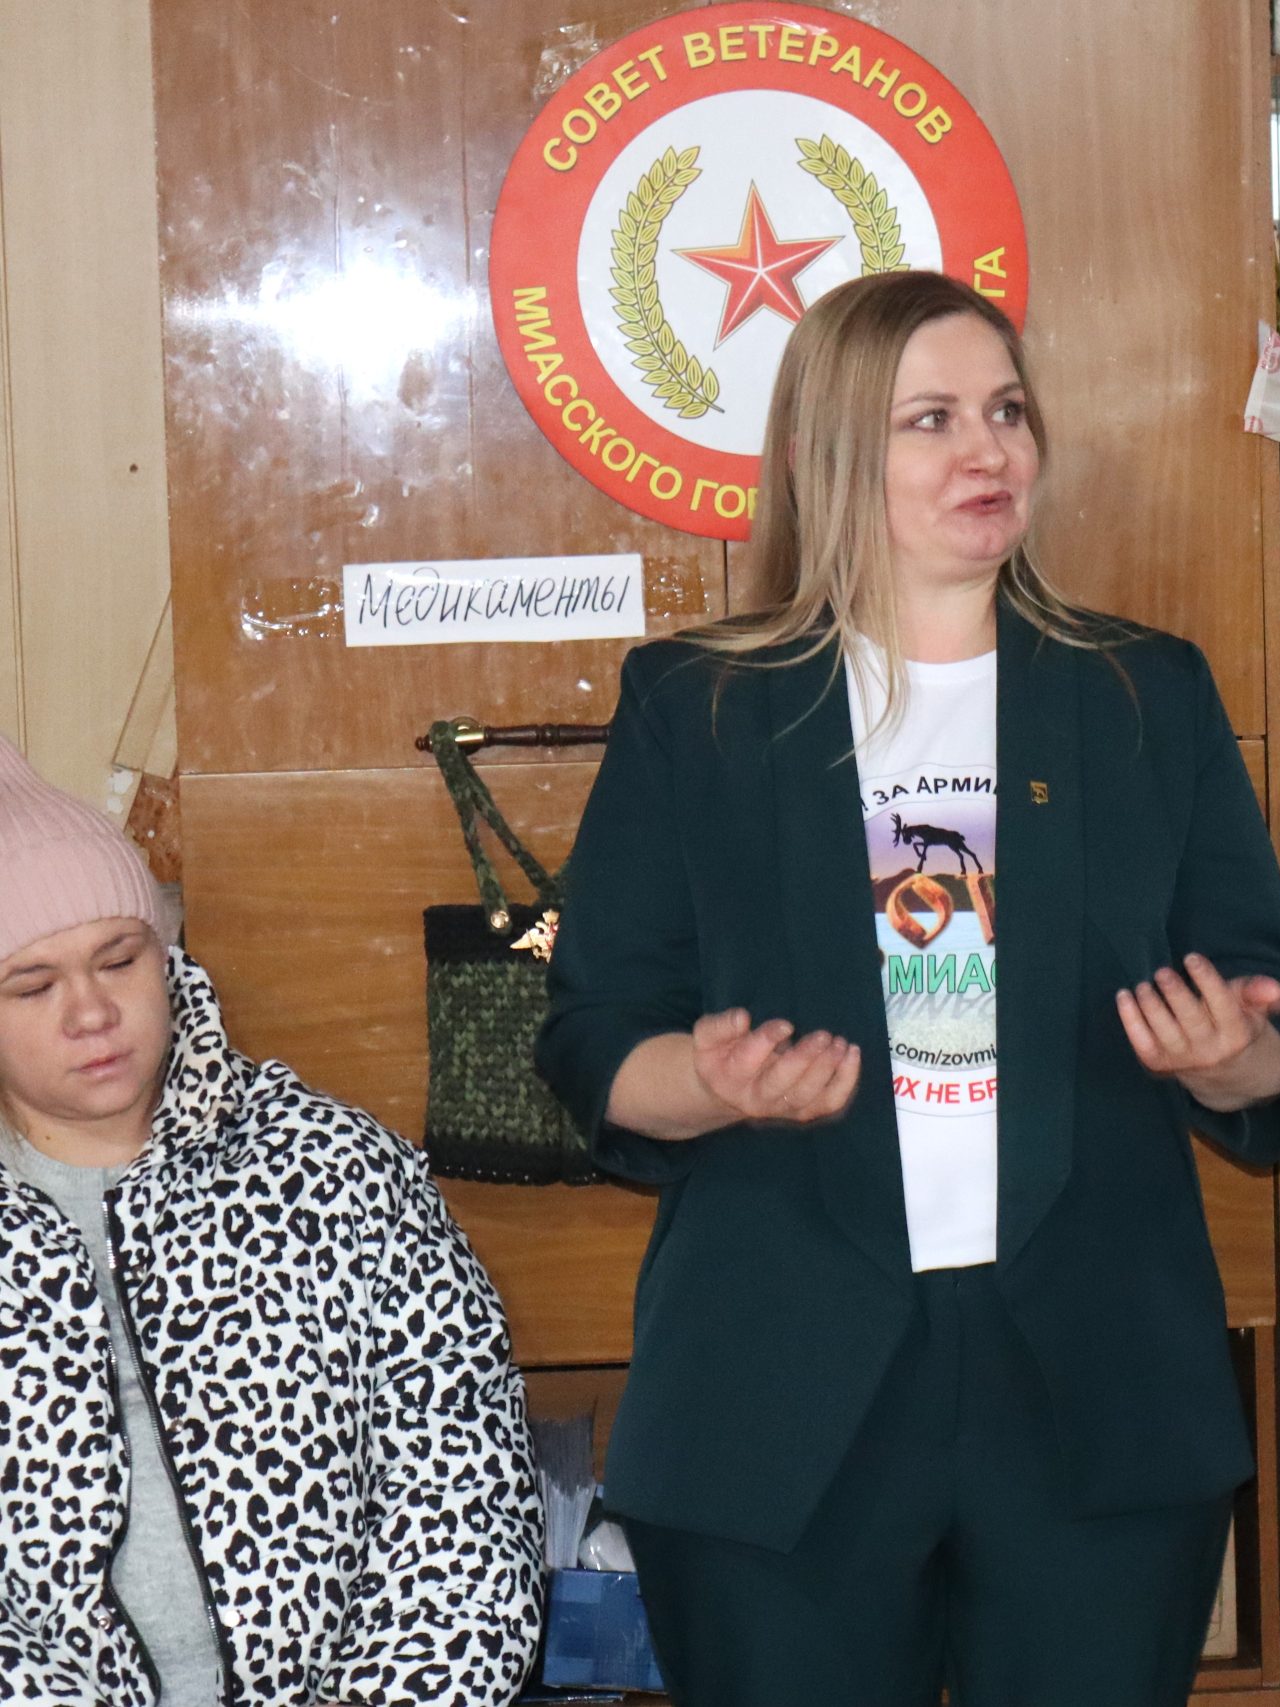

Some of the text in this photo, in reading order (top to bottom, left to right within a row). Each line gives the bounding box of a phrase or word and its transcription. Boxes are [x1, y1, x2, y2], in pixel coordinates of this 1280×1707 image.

[543, 24, 954, 172] СОВЕТ ВЕТЕРАНОВ
[512, 286, 684, 501] МИАССКОГО
[973, 246, 1007, 298] ГА
[358, 566, 630, 628] Медикаменты
[872, 783, 909, 806] ЗА
[888, 953, 997, 995] МИА
[888, 1037, 997, 1066] .com/zovmi
[892, 1075, 998, 1104] ИХ НЕ БР
